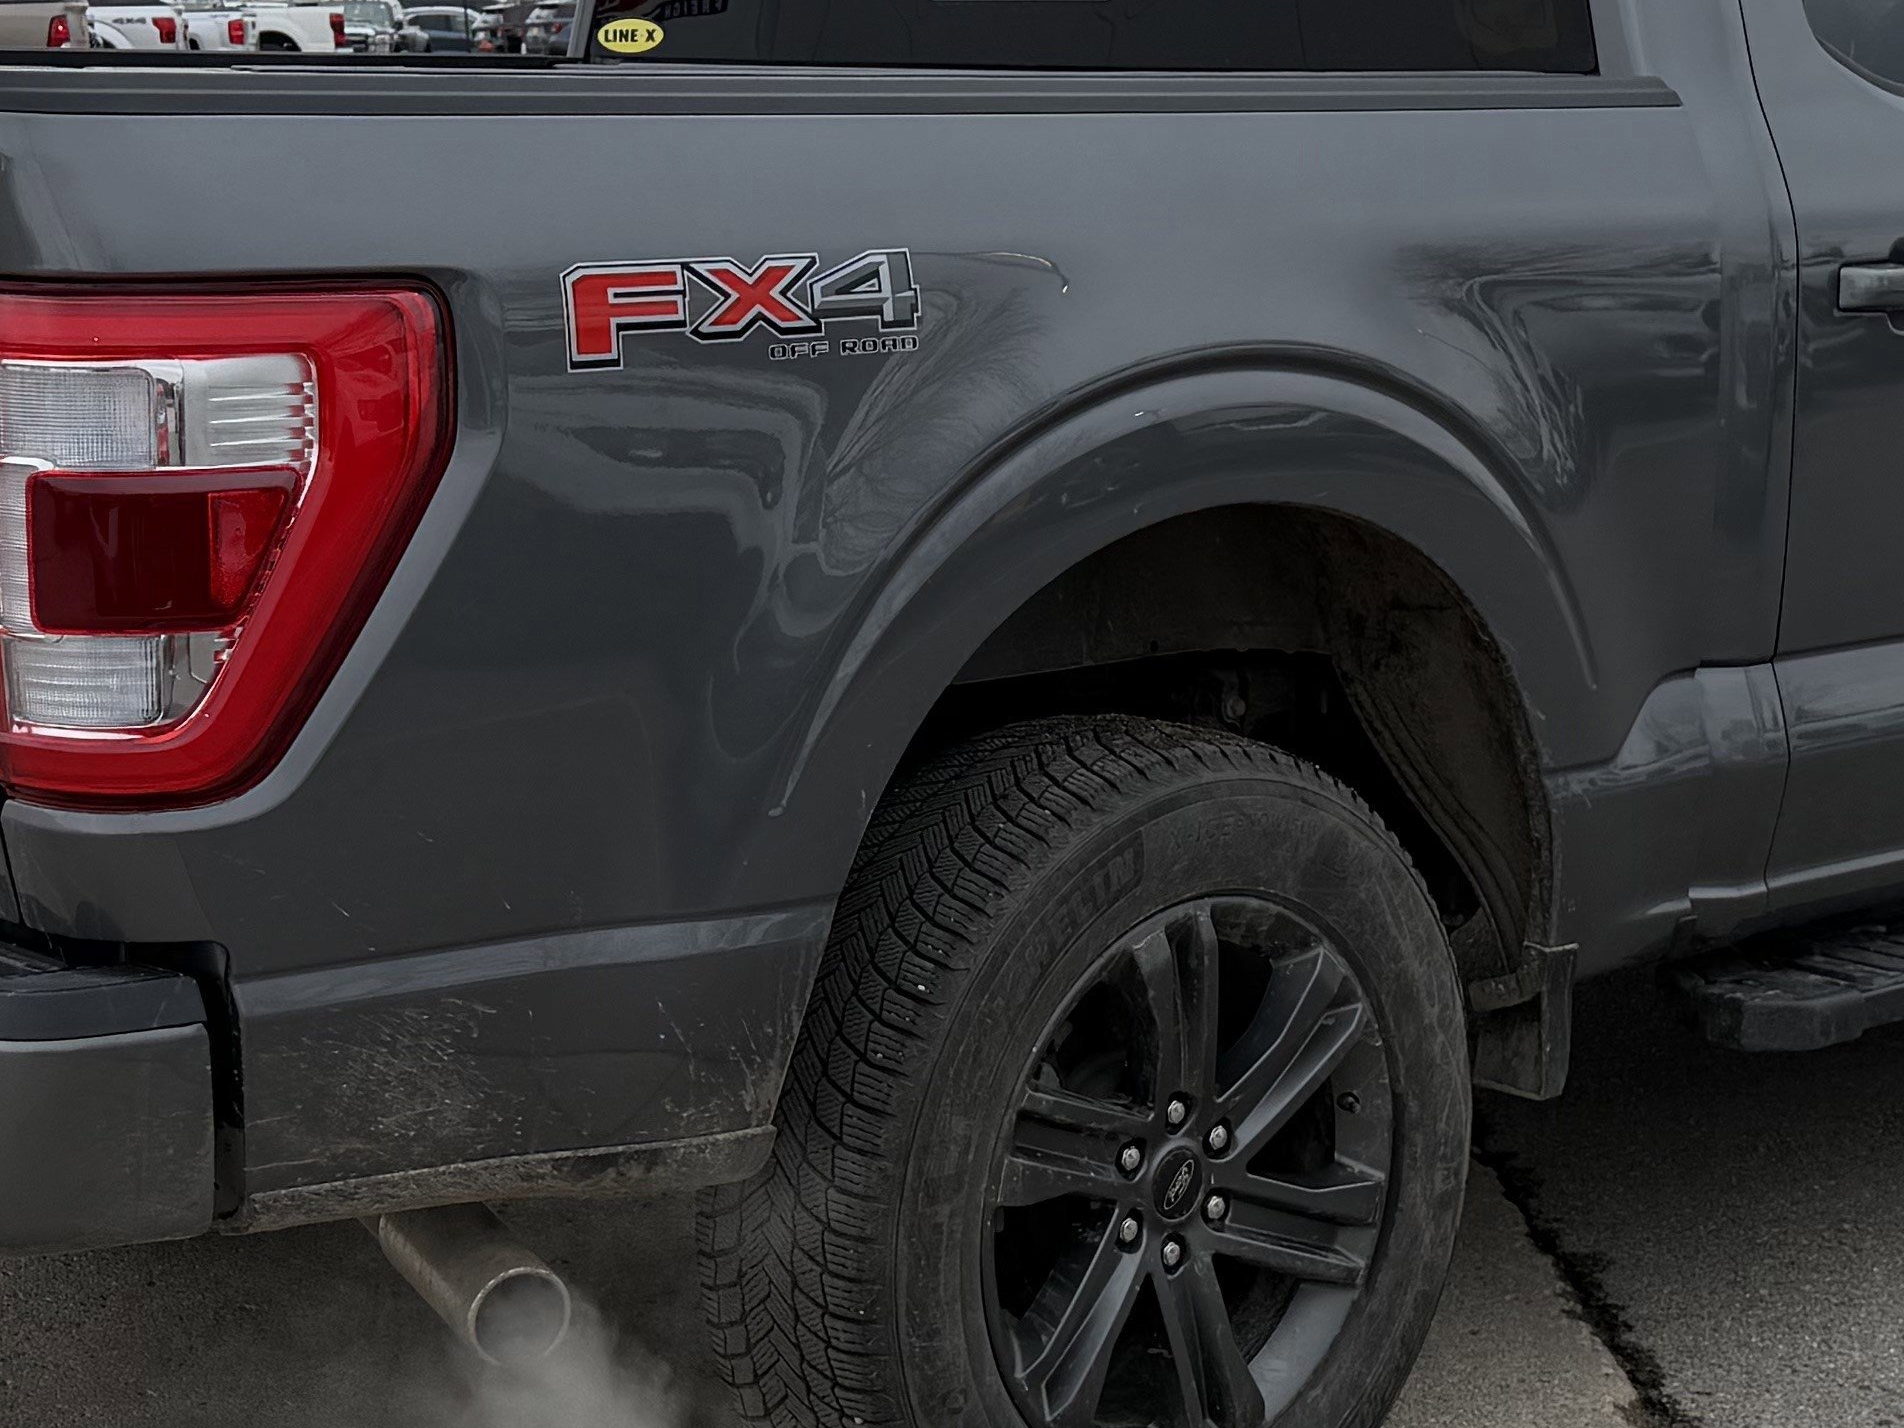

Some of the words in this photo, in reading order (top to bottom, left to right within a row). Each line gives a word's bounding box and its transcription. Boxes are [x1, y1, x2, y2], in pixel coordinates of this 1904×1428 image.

[559, 247, 923, 373] FX4
[769, 343, 831, 361] OFF
[839, 335, 920, 357] ROAD
